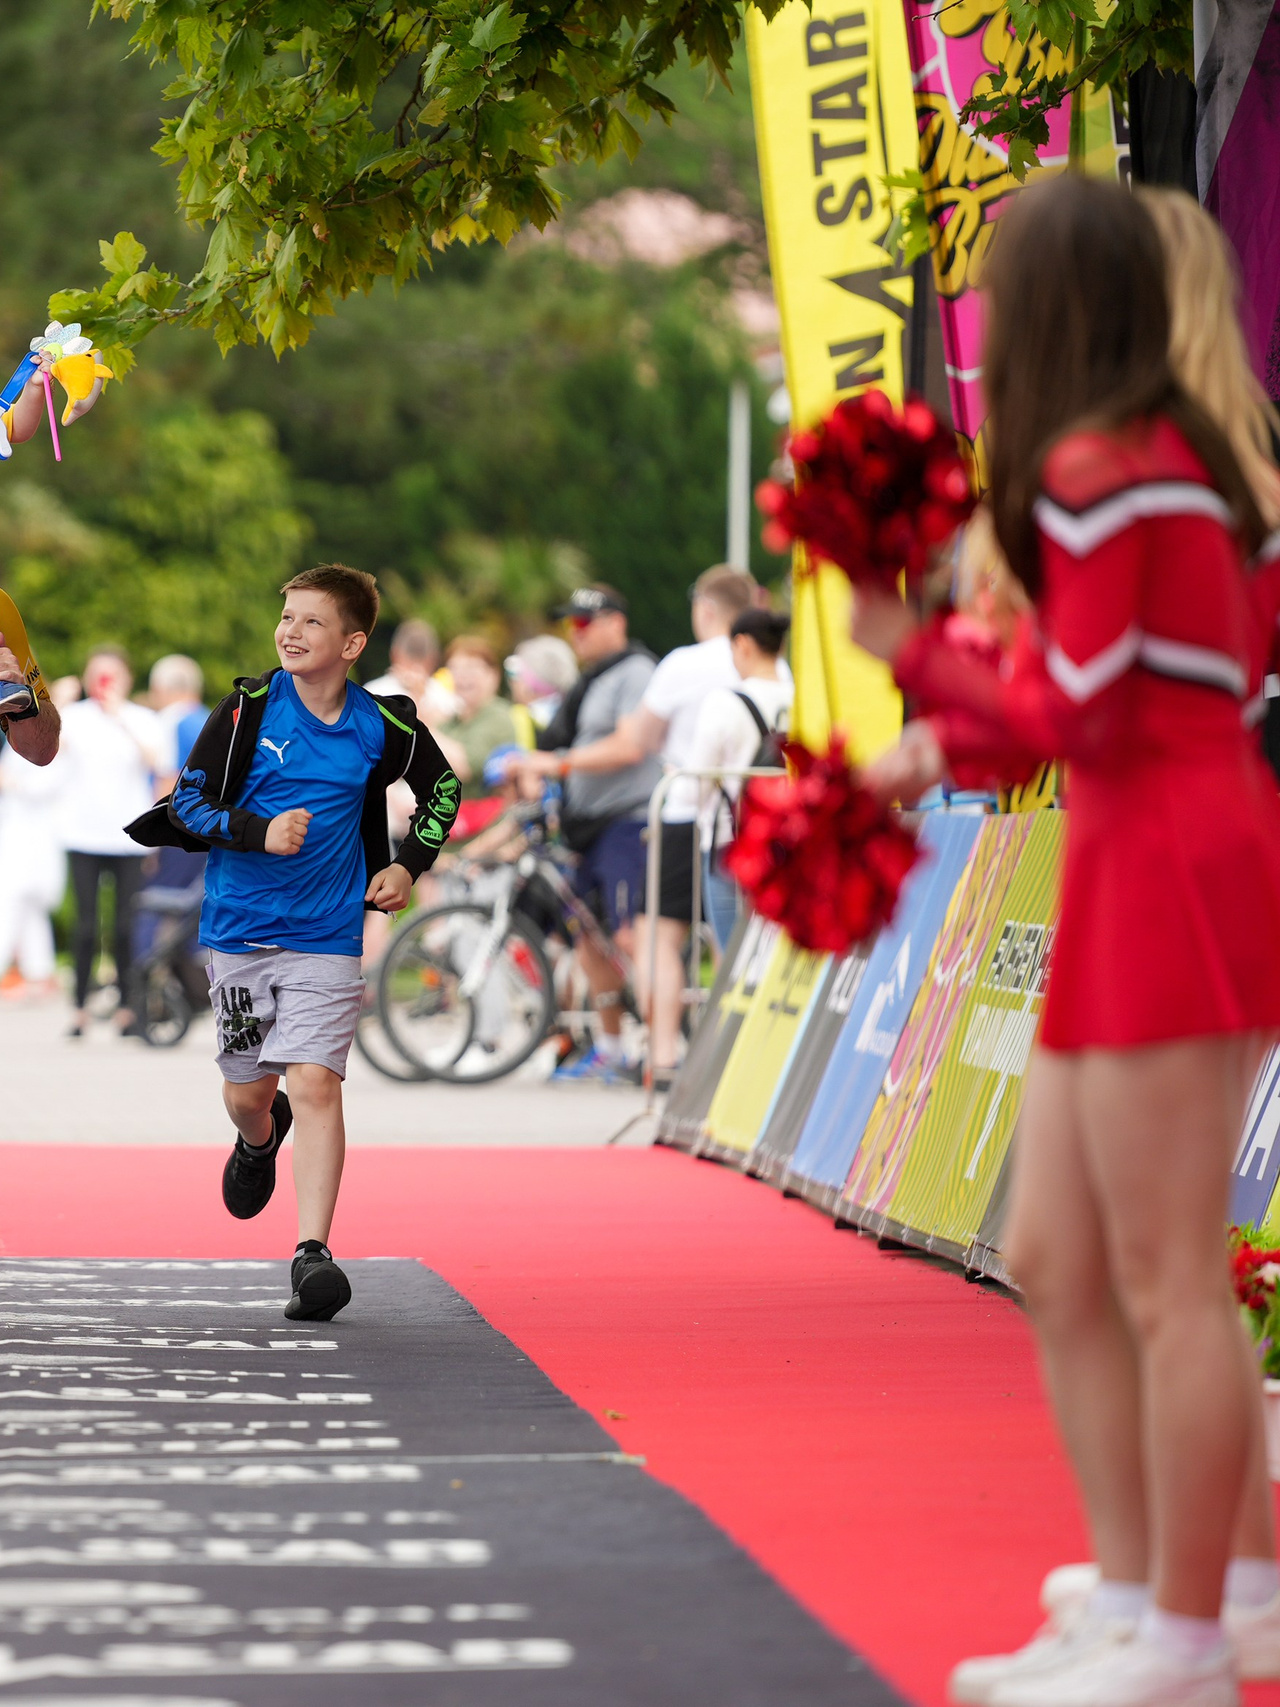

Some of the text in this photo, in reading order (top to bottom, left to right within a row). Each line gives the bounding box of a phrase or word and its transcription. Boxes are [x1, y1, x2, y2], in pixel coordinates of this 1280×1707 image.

[804, 11, 873, 227] STAR
[220, 986, 253, 1016] AIR
[51, 1336, 338, 1348] STAR
